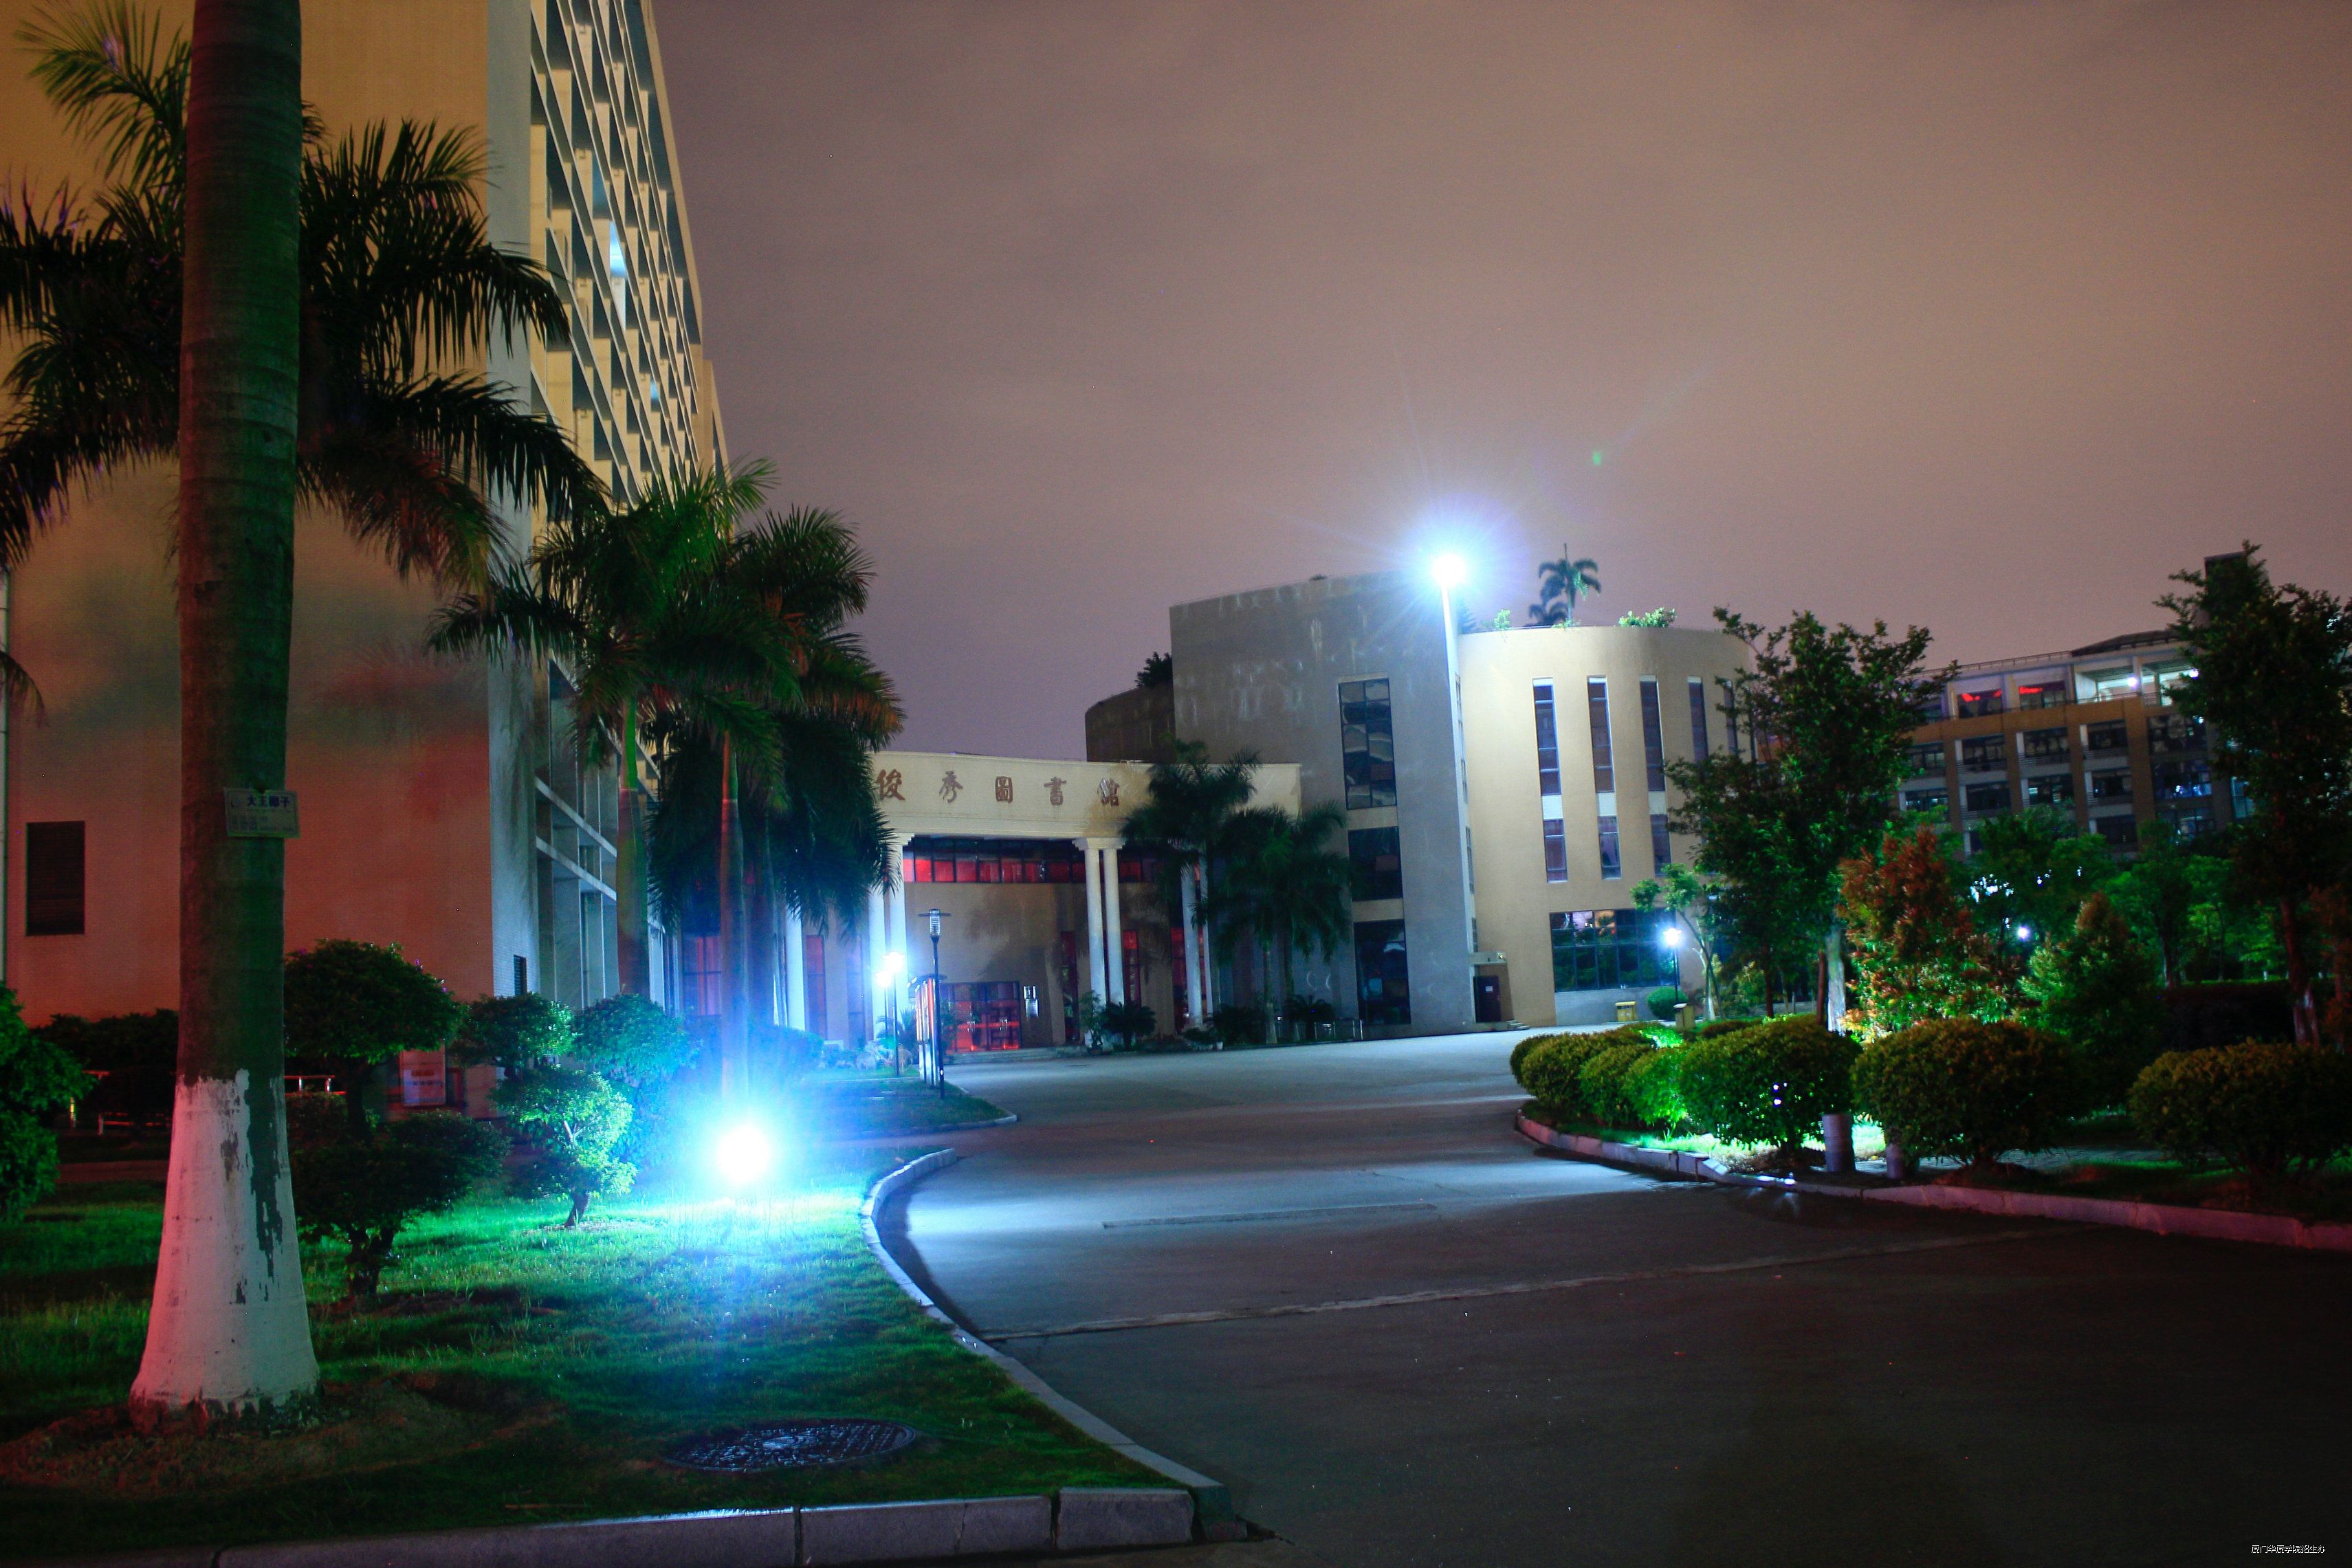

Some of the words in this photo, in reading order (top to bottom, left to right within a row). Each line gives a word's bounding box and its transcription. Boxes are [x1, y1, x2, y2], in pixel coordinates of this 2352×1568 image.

[875, 768, 1121, 807] 俊秀圖書館
